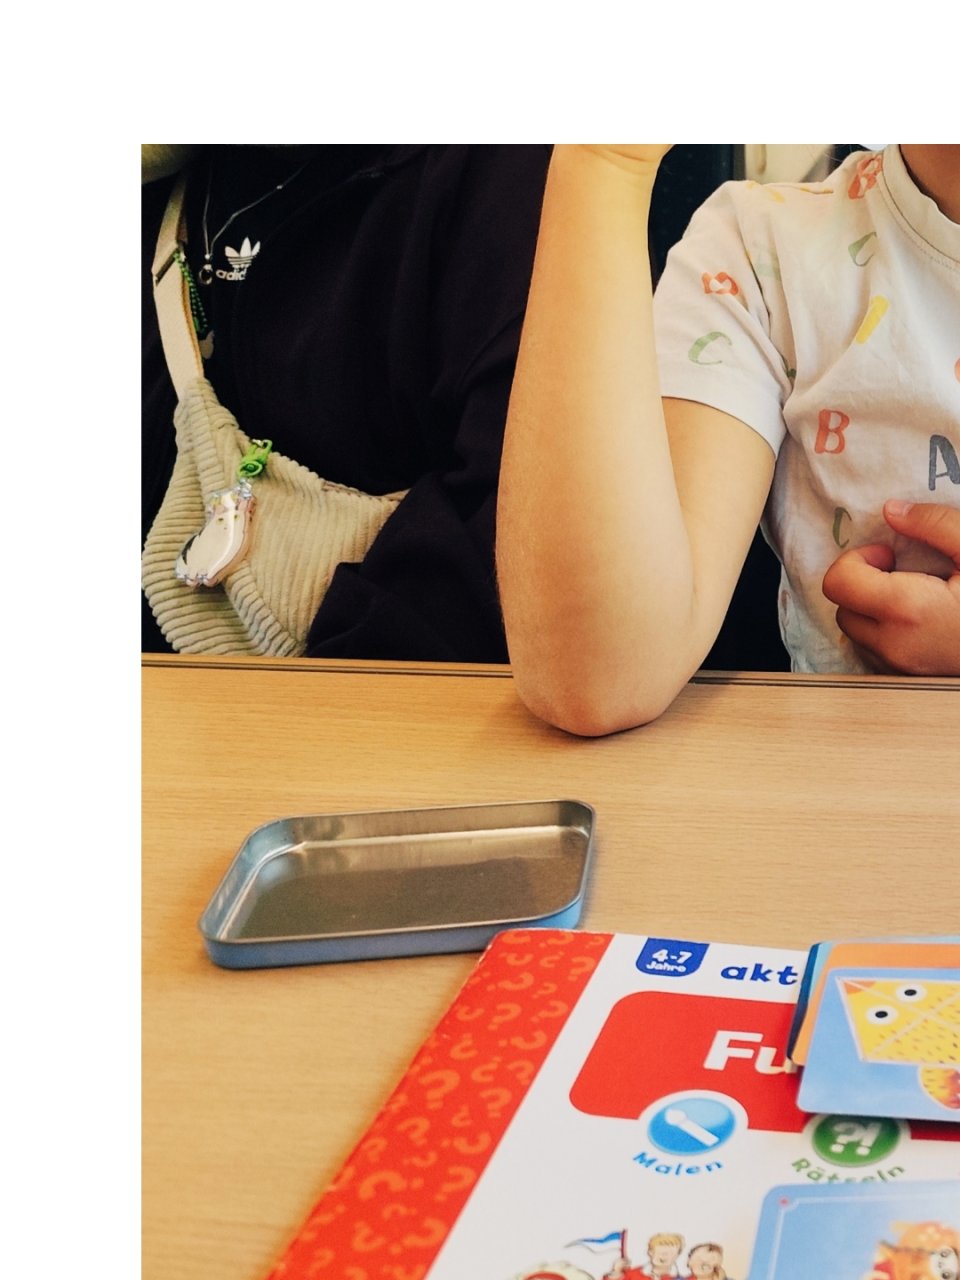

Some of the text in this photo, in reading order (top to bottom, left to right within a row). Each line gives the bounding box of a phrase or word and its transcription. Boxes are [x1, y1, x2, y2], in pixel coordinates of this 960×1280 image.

[814, 408, 850, 454] B
[646, 961, 687, 973] Jahre
[651, 949, 693, 965] 4-7
[720, 963, 799, 986] akt
[632, 1152, 723, 1176] Malen
